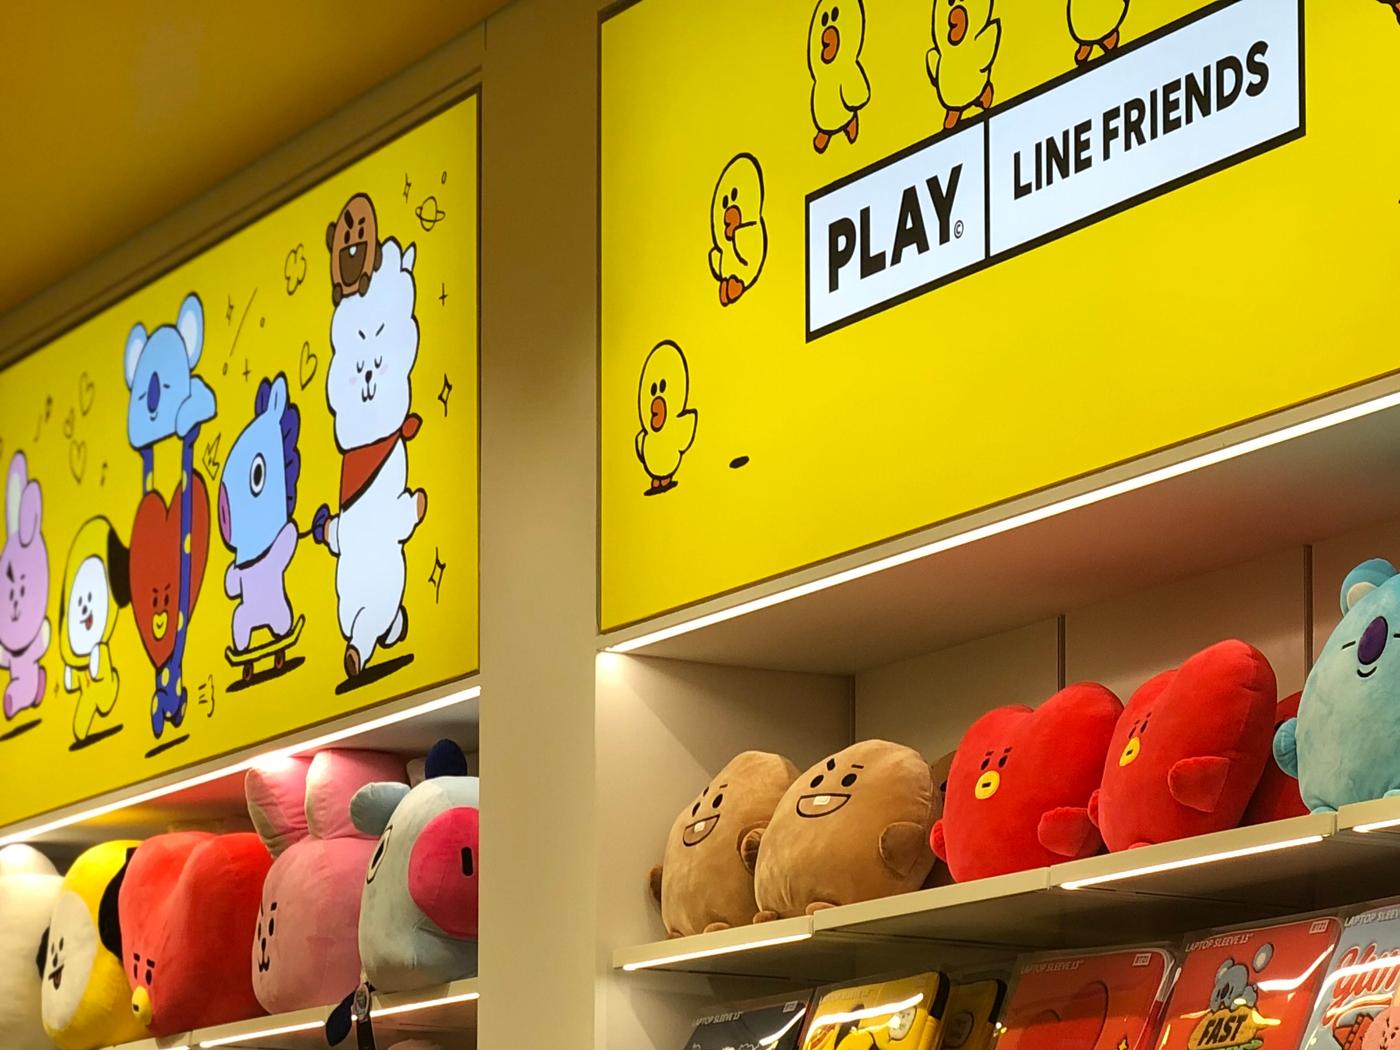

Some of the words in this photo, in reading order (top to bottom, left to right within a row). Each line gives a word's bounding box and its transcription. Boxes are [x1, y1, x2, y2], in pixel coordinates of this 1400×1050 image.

[1014, 118, 1092, 200] LINE
[1102, 40, 1269, 161] FRIENDS
[828, 164, 962, 293] PLAY
[1344, 914, 1377, 927] LAPTOP
[1185, 940, 1214, 952] LAPTOP
[1215, 936, 1239, 948] SLEEVE
[1198, 1015, 1248, 1045] FAST
